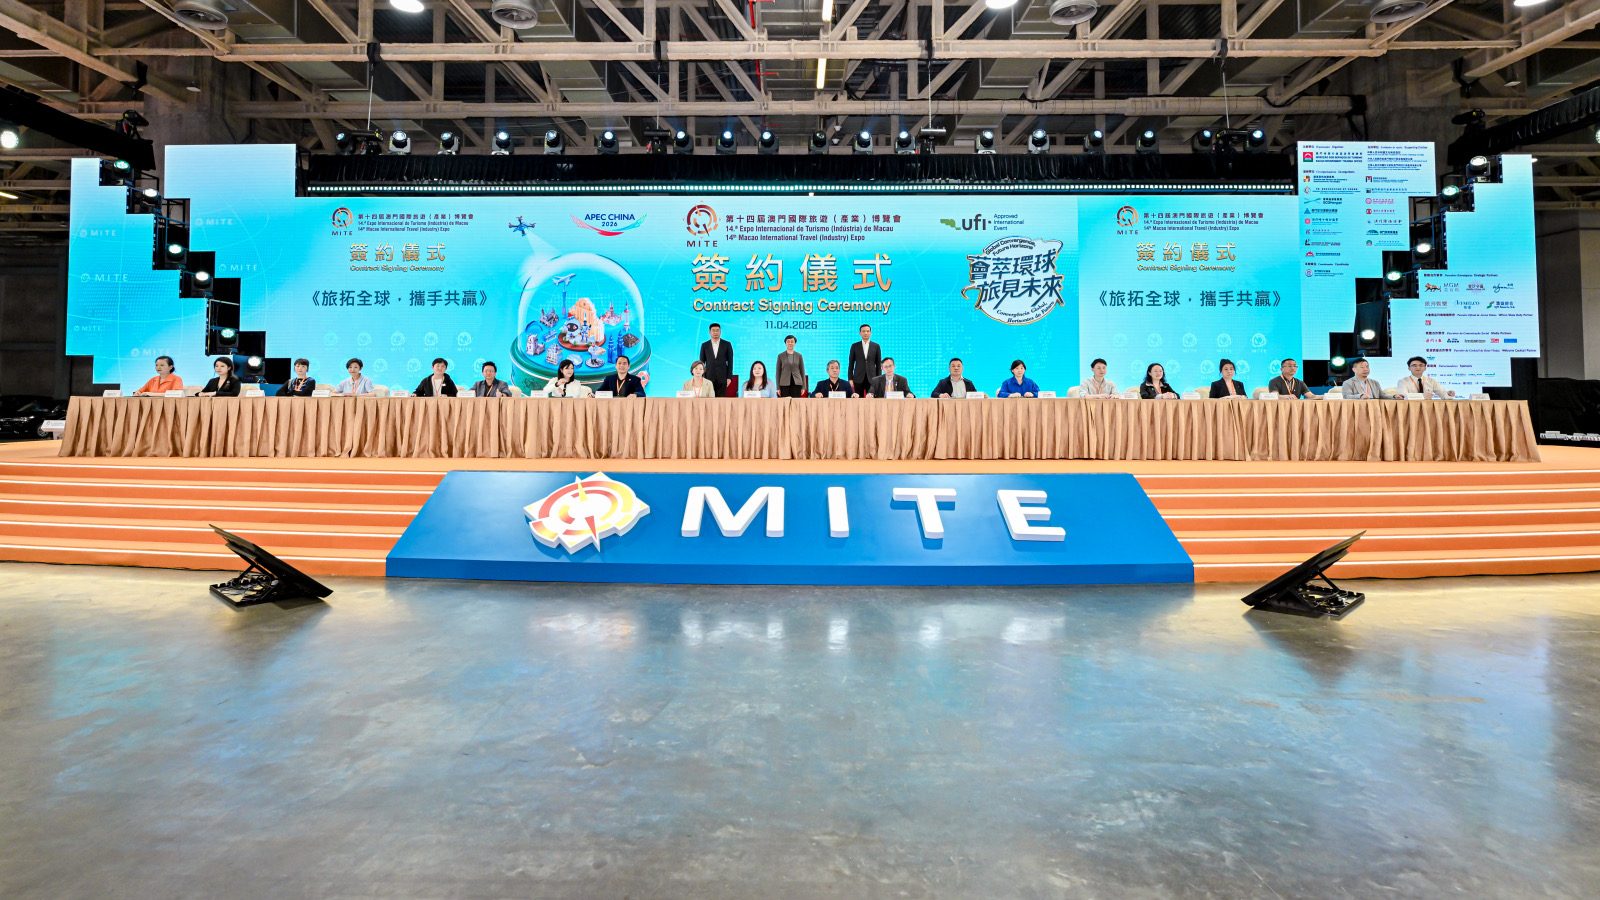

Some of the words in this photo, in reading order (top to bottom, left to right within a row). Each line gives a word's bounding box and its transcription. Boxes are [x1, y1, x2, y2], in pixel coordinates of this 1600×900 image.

[740, 225, 754, 233] Expo
[820, 234, 849, 242] (Industry)
[850, 234, 865, 242] Expo
[686, 240, 718, 248] MITE
[350, 242, 446, 262] 簽約儀式
[1136, 242, 1236, 262] 簽約儀式
[230, 264, 257, 272] MITE
[350, 264, 380, 272] Contract
[381, 264, 408, 273] Signing
[410, 264, 445, 272] Ceremony
[691, 253, 893, 292] 簽約儀式
[1137, 264, 1168, 272] Contract
[1169, 264, 1197, 272] Signing
[1199, 264, 1236, 272] Ceremony
[95, 273, 129, 282] MITE
[975, 275, 1064, 310] 旅見未來
[693, 299, 755, 312] Contract
[758, 299, 813, 314] Signing
[817, 299, 891, 314] Ceremony
[765, 321, 818, 330] 11.04.2026
[680, 486, 1067, 541] MITE
